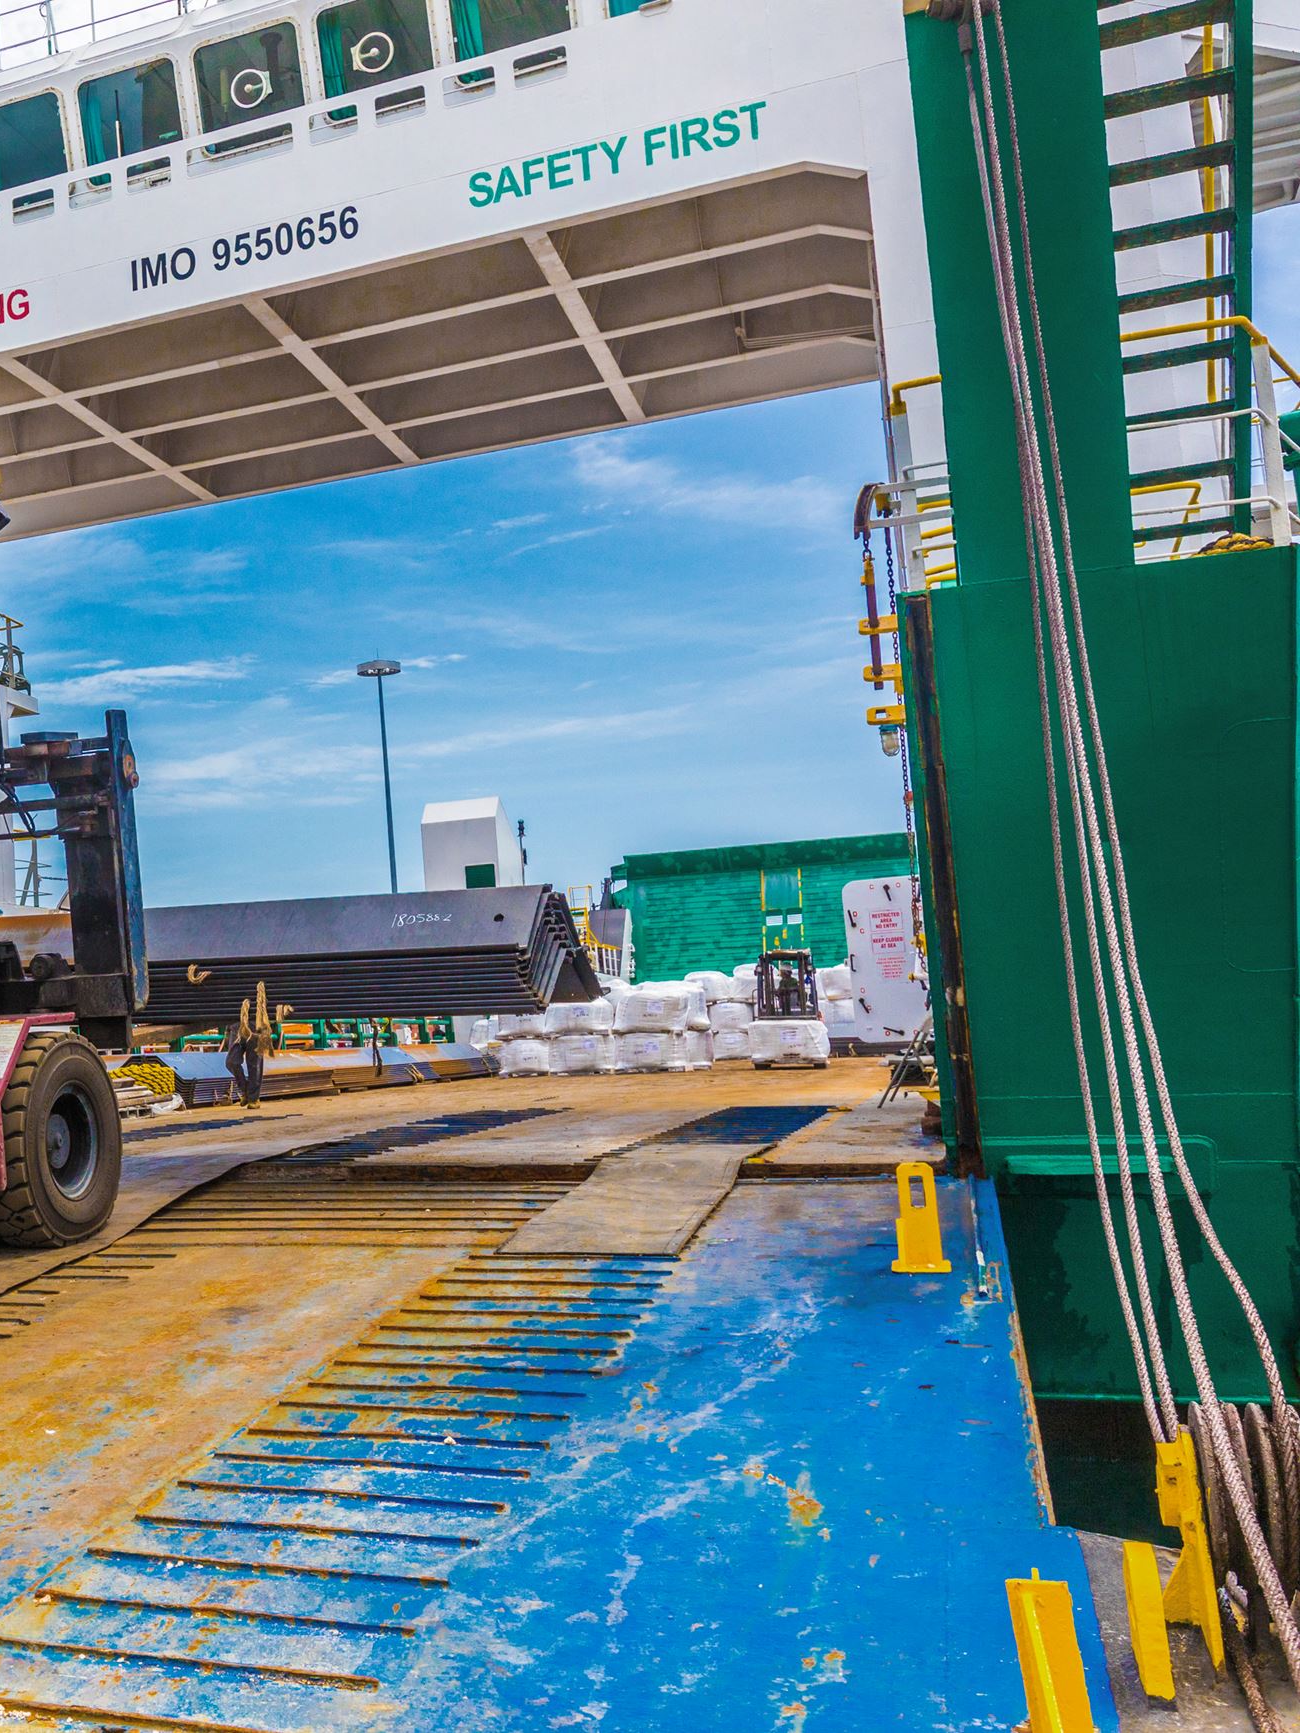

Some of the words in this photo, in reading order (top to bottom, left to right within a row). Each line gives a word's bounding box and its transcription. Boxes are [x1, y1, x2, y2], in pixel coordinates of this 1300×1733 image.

[468, 136, 628, 208] SAFETY
[644, 101, 766, 167] FIRST
[131, 247, 196, 291] IMO
[212, 205, 359, 271] 9550656
